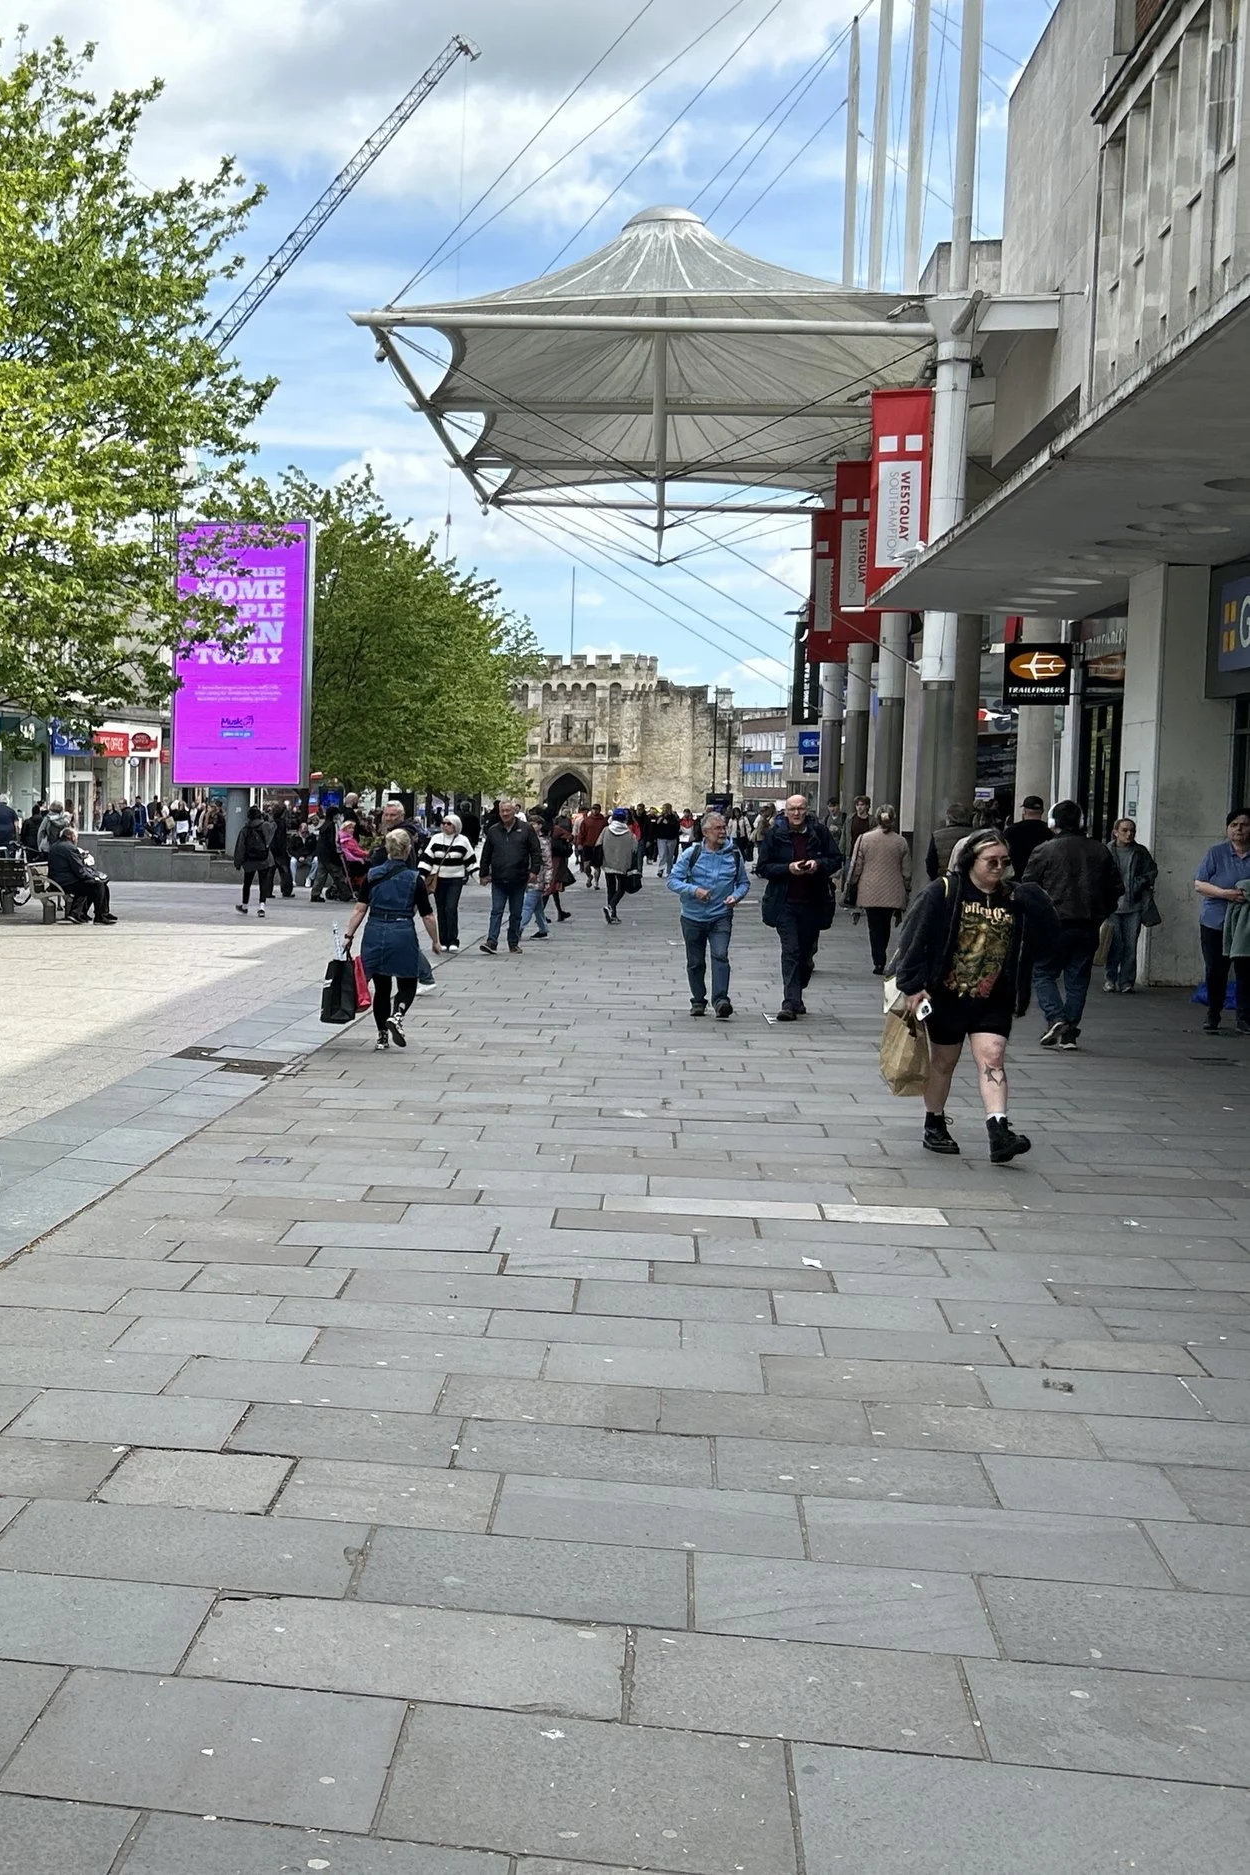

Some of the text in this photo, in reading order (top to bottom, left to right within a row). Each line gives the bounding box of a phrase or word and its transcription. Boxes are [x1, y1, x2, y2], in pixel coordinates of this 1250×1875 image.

[886, 471, 899, 561] SOUTHAMPTON
[898, 471, 912, 542] WESTQUAY
[857, 527, 868, 584] WESTQUAY
[1008, 686, 1066, 695] TRAILFINDERS
